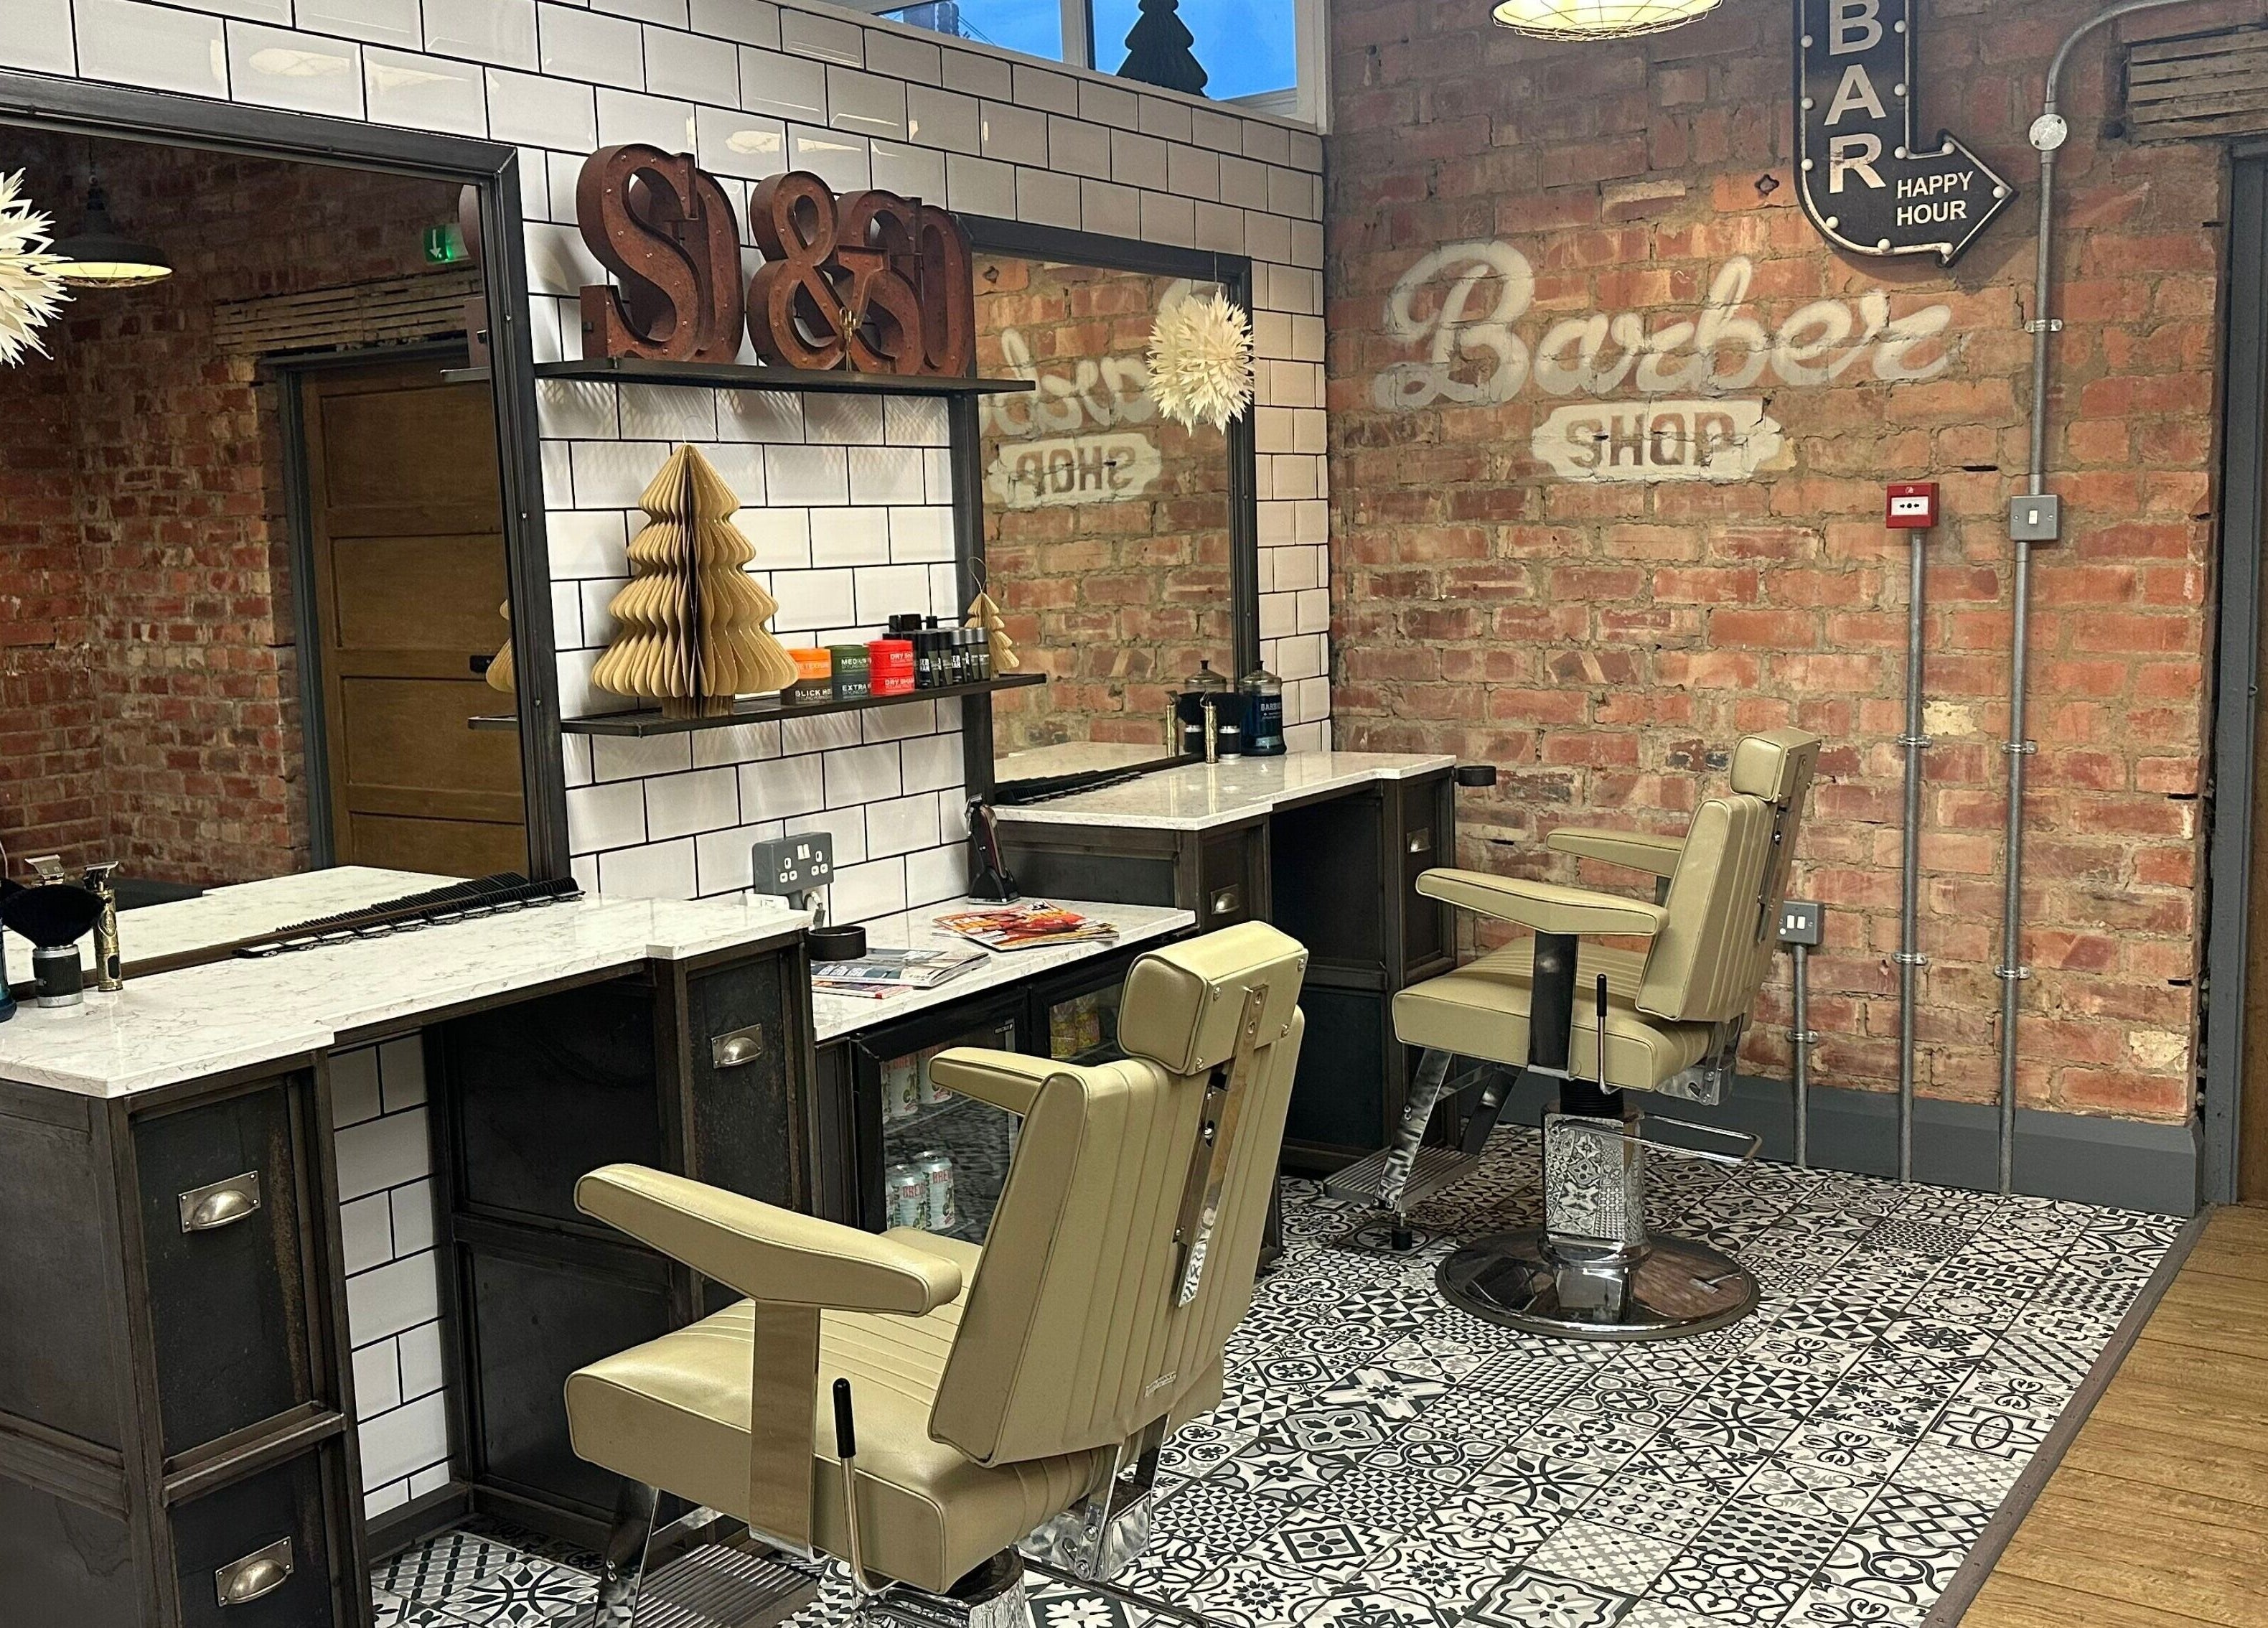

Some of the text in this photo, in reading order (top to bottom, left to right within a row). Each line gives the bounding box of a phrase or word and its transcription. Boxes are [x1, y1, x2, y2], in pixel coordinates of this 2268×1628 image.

[1824, 0, 1886, 194] BAR
[1897, 171, 1973, 199] HAPPY
[1897, 200, 1967, 226] HOUR
[1372, 240, 1951, 409] Barber
[1566, 412, 1736, 469] SHOP
